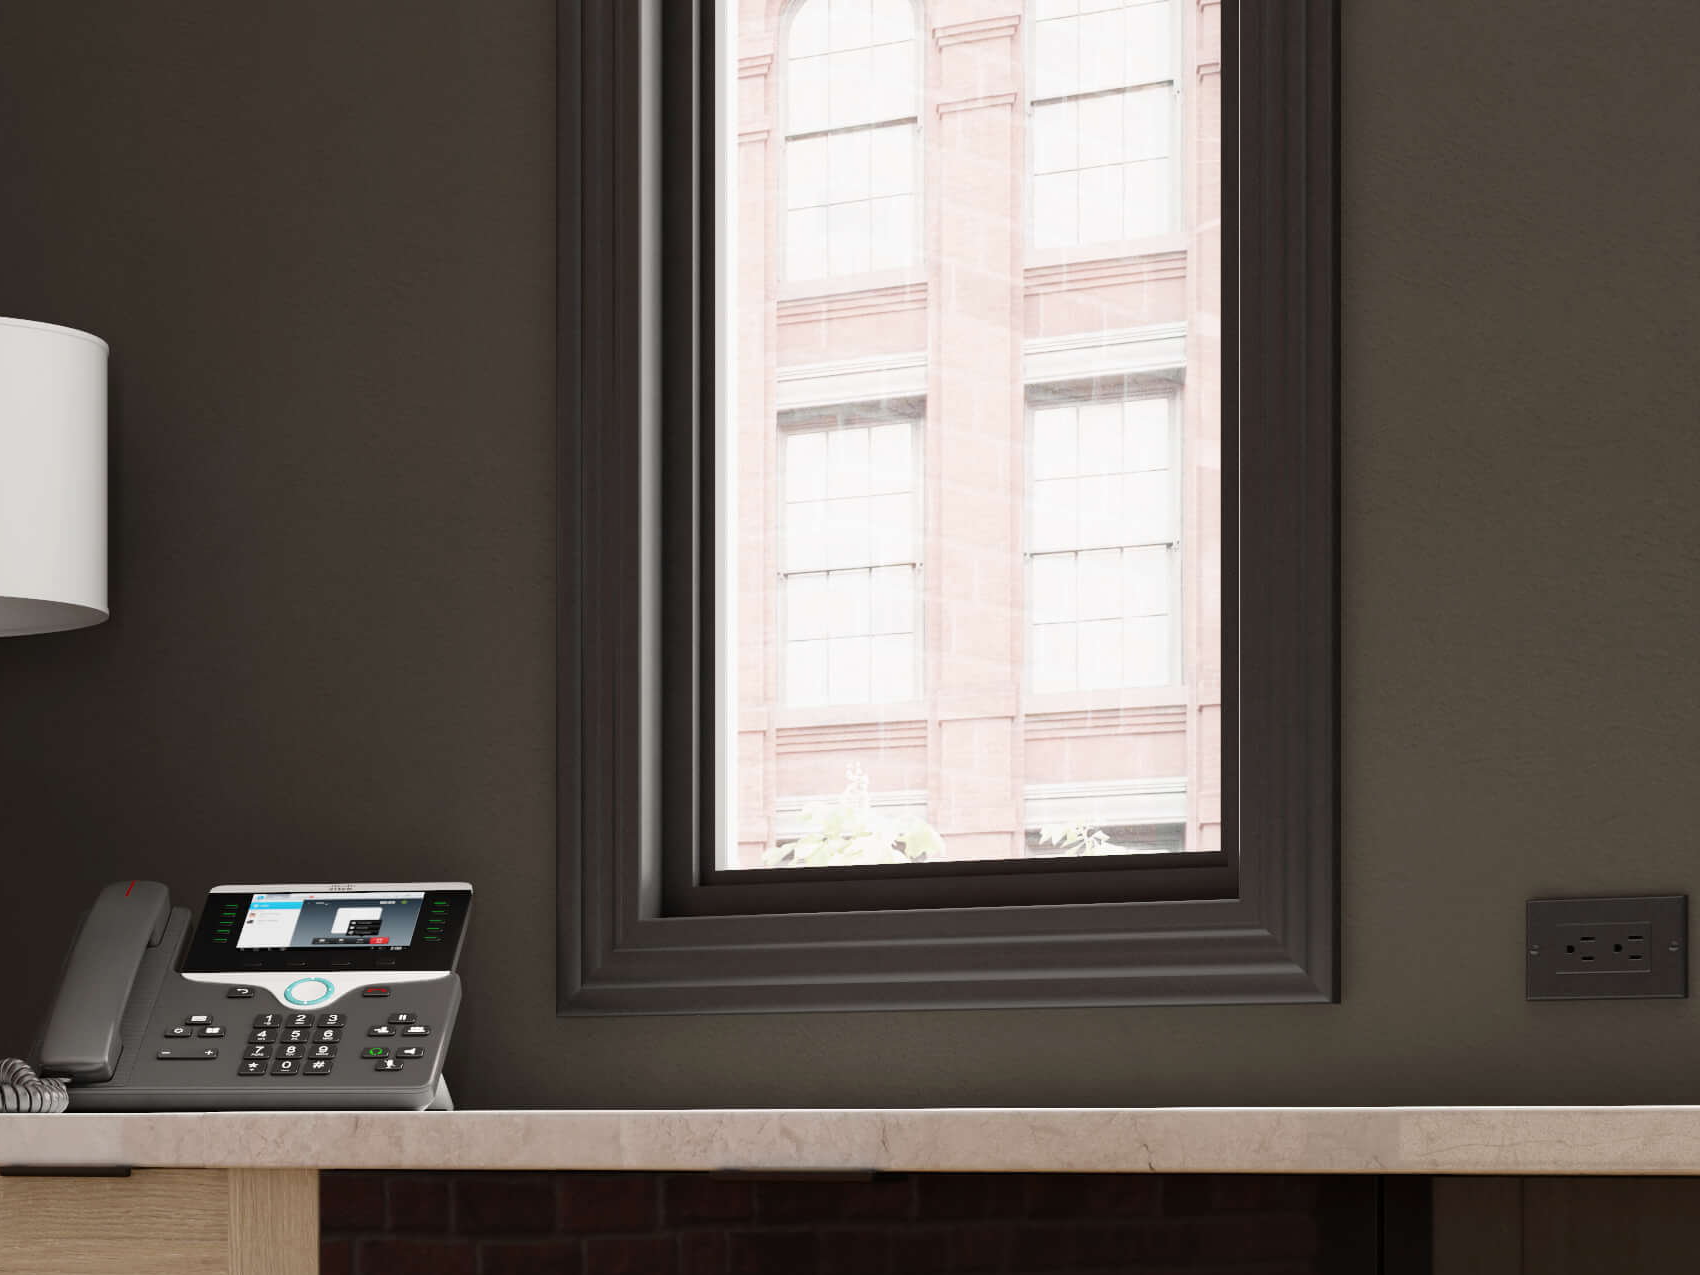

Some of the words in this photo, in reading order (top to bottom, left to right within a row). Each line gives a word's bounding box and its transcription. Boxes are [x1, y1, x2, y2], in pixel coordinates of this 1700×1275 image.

[265, 1014, 273, 1022] 1
[295, 1014, 307, 1022] 2
[328, 1014, 339, 1022] 3
[323, 1029, 334, 1037] 6
[255, 1046, 265, 1054] 7
[286, 1045, 297, 1053] 8
[318, 1045, 329, 1053] 9
[281, 1061, 292, 1069] 0
